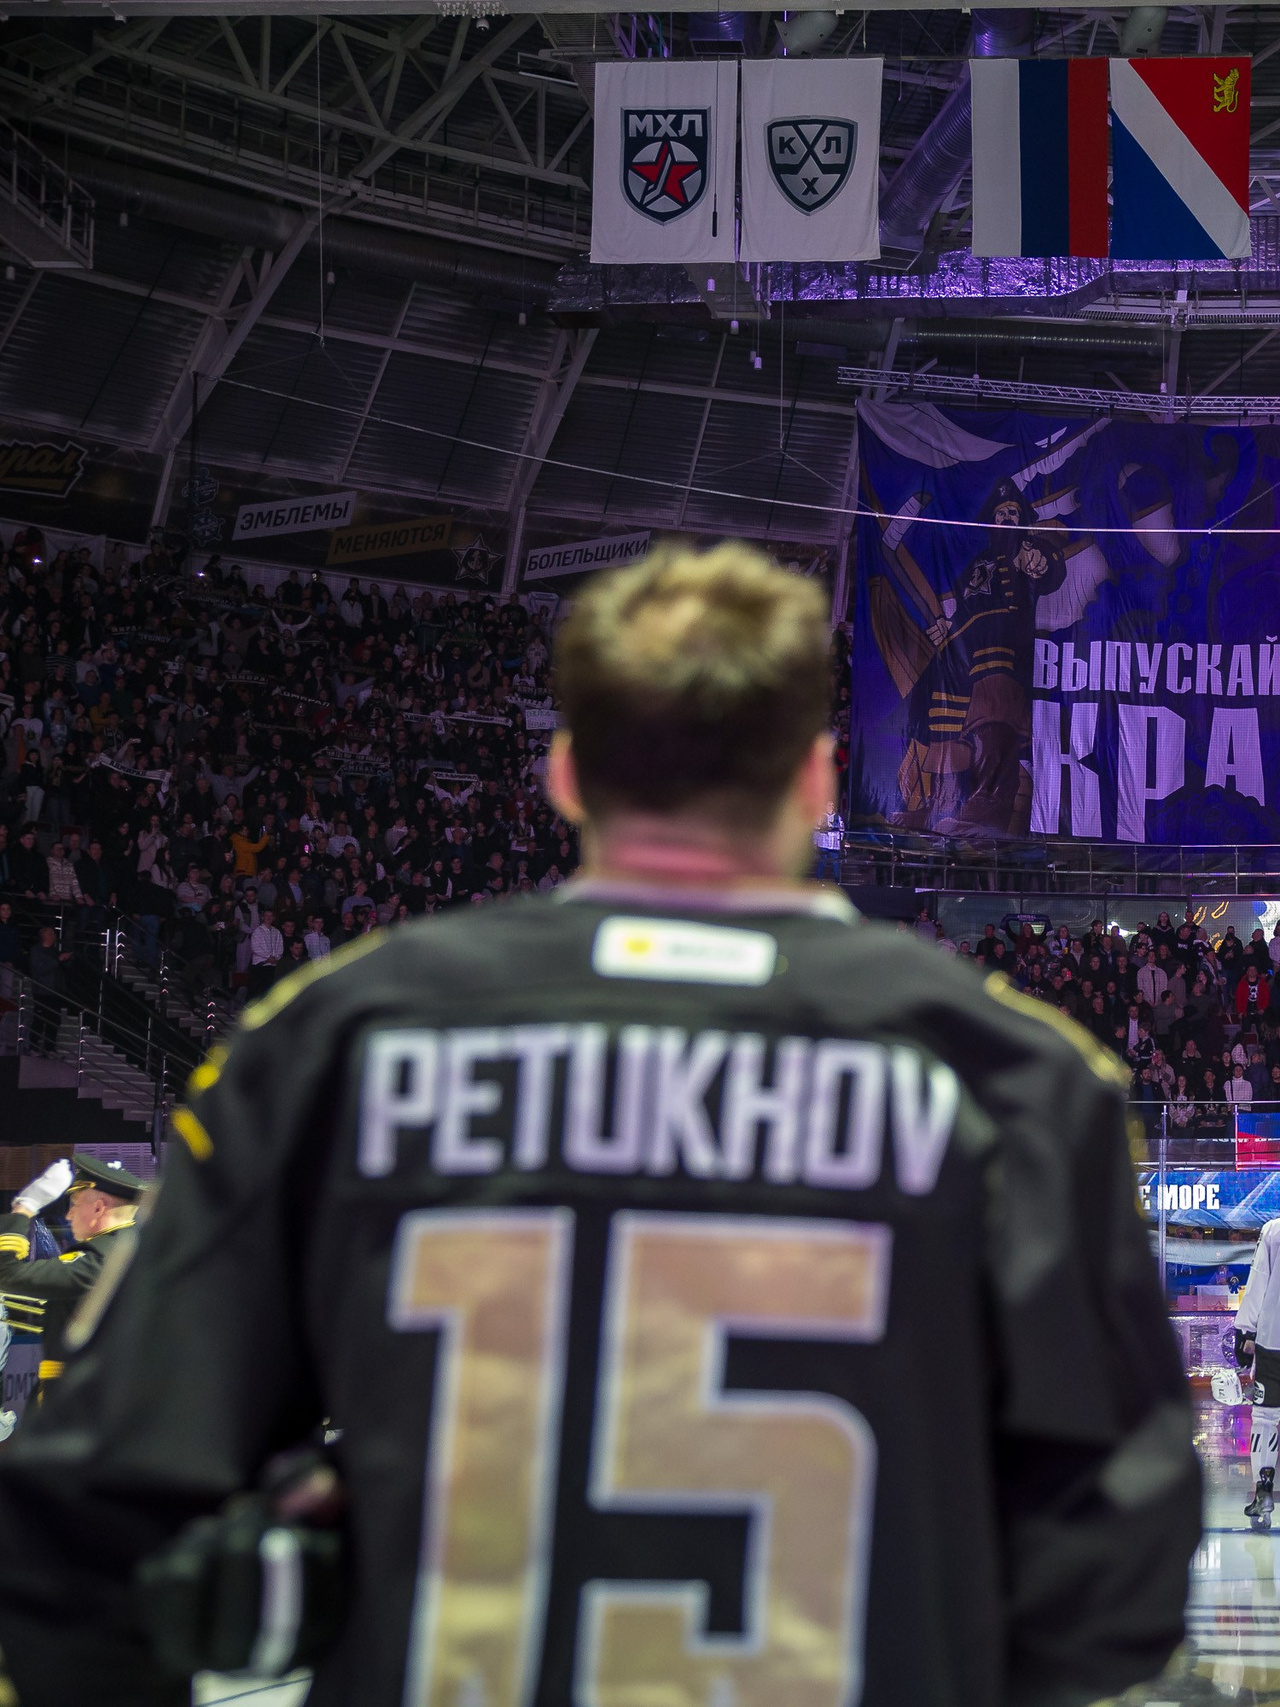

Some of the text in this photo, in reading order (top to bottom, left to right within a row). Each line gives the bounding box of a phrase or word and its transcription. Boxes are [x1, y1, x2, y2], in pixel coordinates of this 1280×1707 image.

[629, 114, 703, 137] МХЛ
[0, 448, 79, 478] рал
[240, 501, 350, 531] ЭМБЛЕМЫ
[333, 523, 447, 555] МЕНЯЮТСЯ
[527, 538, 649, 572] БОЛЕЛЬЩИКИ
[357, 1022, 960, 1195] PETUKHOV
[1157, 1184, 1220, 1210] МОРЕ
[388, 1203, 891, 1707] 15
